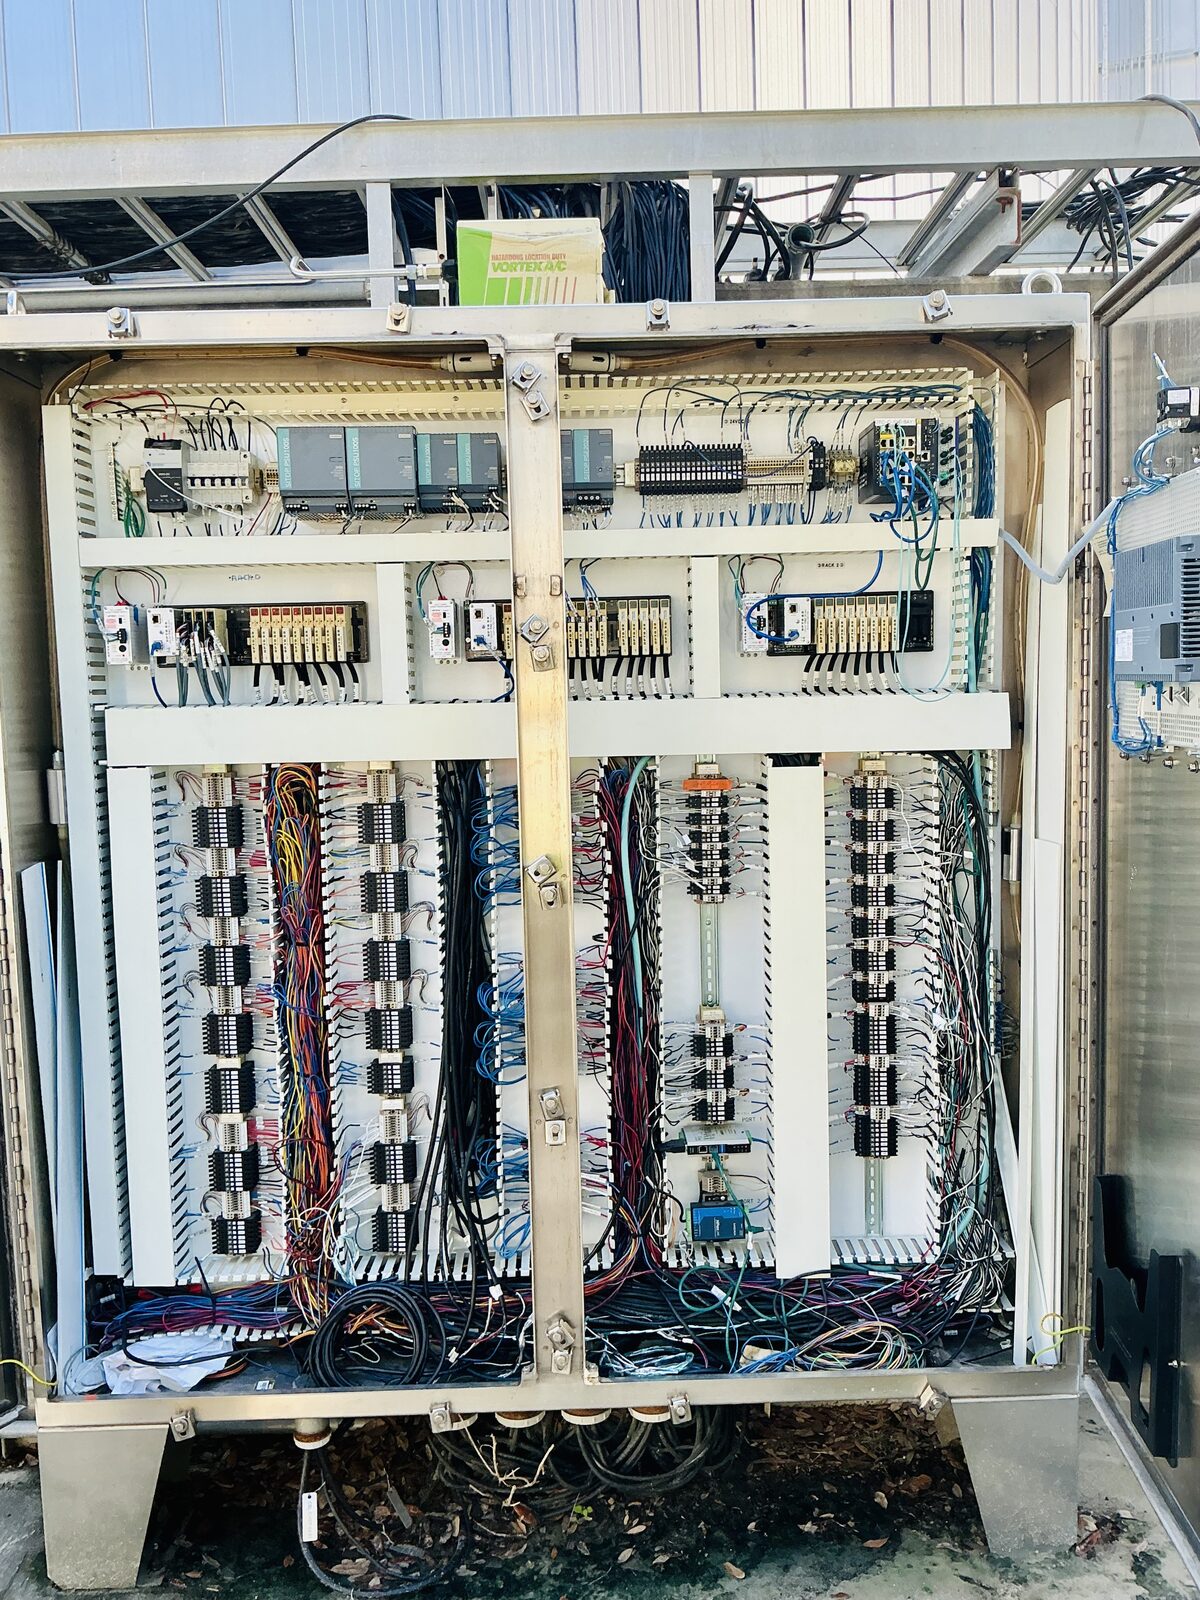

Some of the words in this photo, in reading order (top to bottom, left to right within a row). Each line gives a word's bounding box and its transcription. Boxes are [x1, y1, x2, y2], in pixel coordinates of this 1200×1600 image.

[491, 261, 544, 273] VORTEX
[544, 260, 568, 272] A/C
[284, 467, 292, 488] SITOP
[353, 467, 361, 488] SITOP
